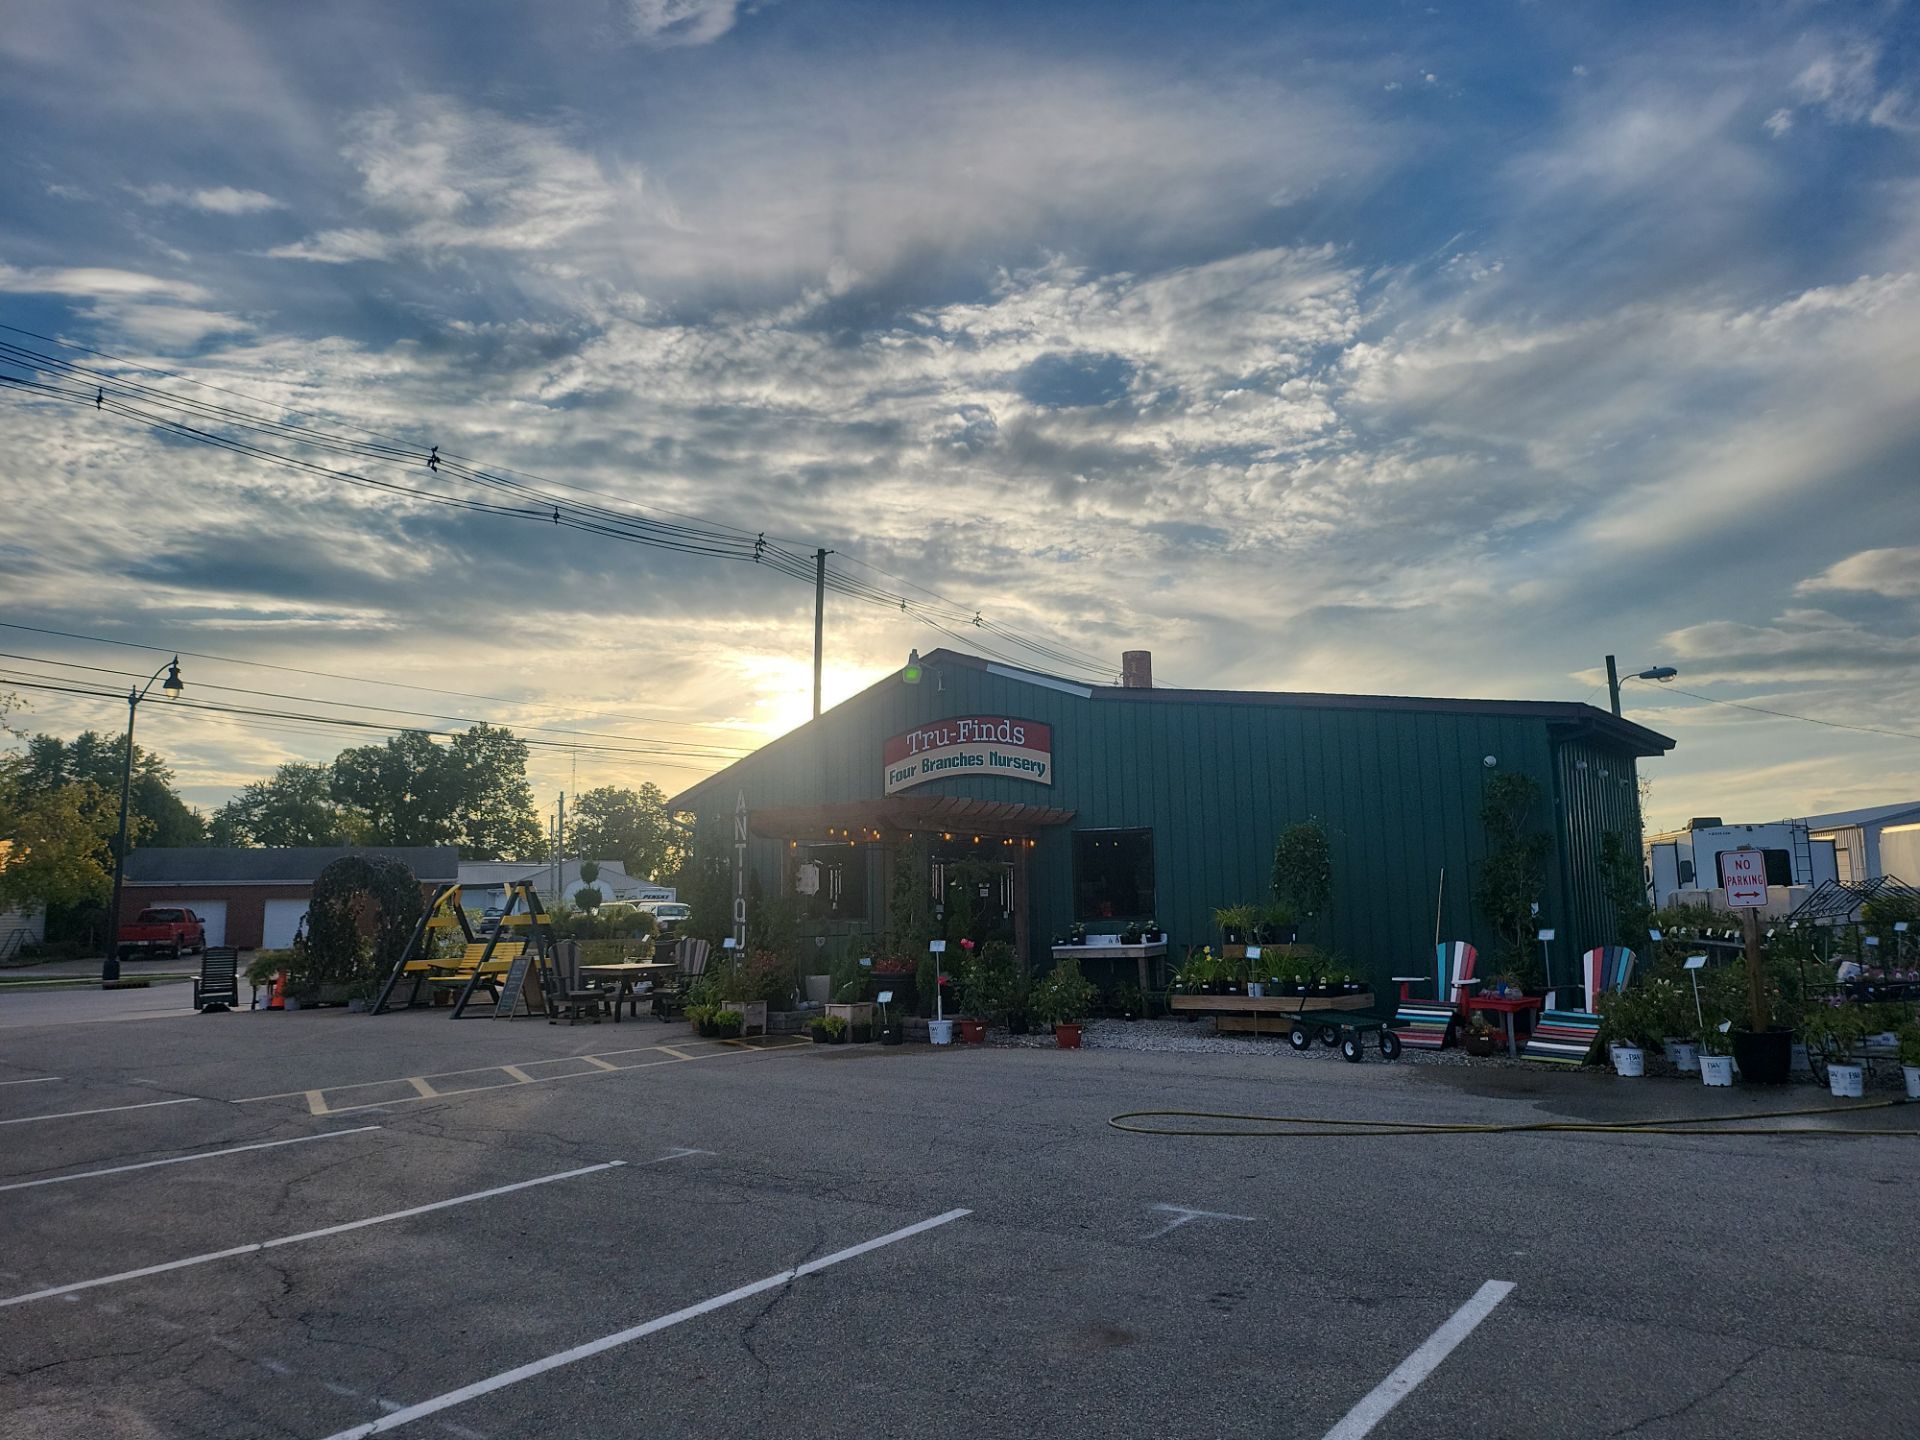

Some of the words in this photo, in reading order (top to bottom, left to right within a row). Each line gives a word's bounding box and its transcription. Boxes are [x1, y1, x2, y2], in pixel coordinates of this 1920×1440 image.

[906, 719, 1025, 756] Tru-Finds
[889, 764, 917, 785] Four
[921, 752, 984, 774] Branches
[989, 751, 1046, 778] Nursery
[1735, 859, 1751, 870] NO
[1727, 875, 1763, 887] PARKING
